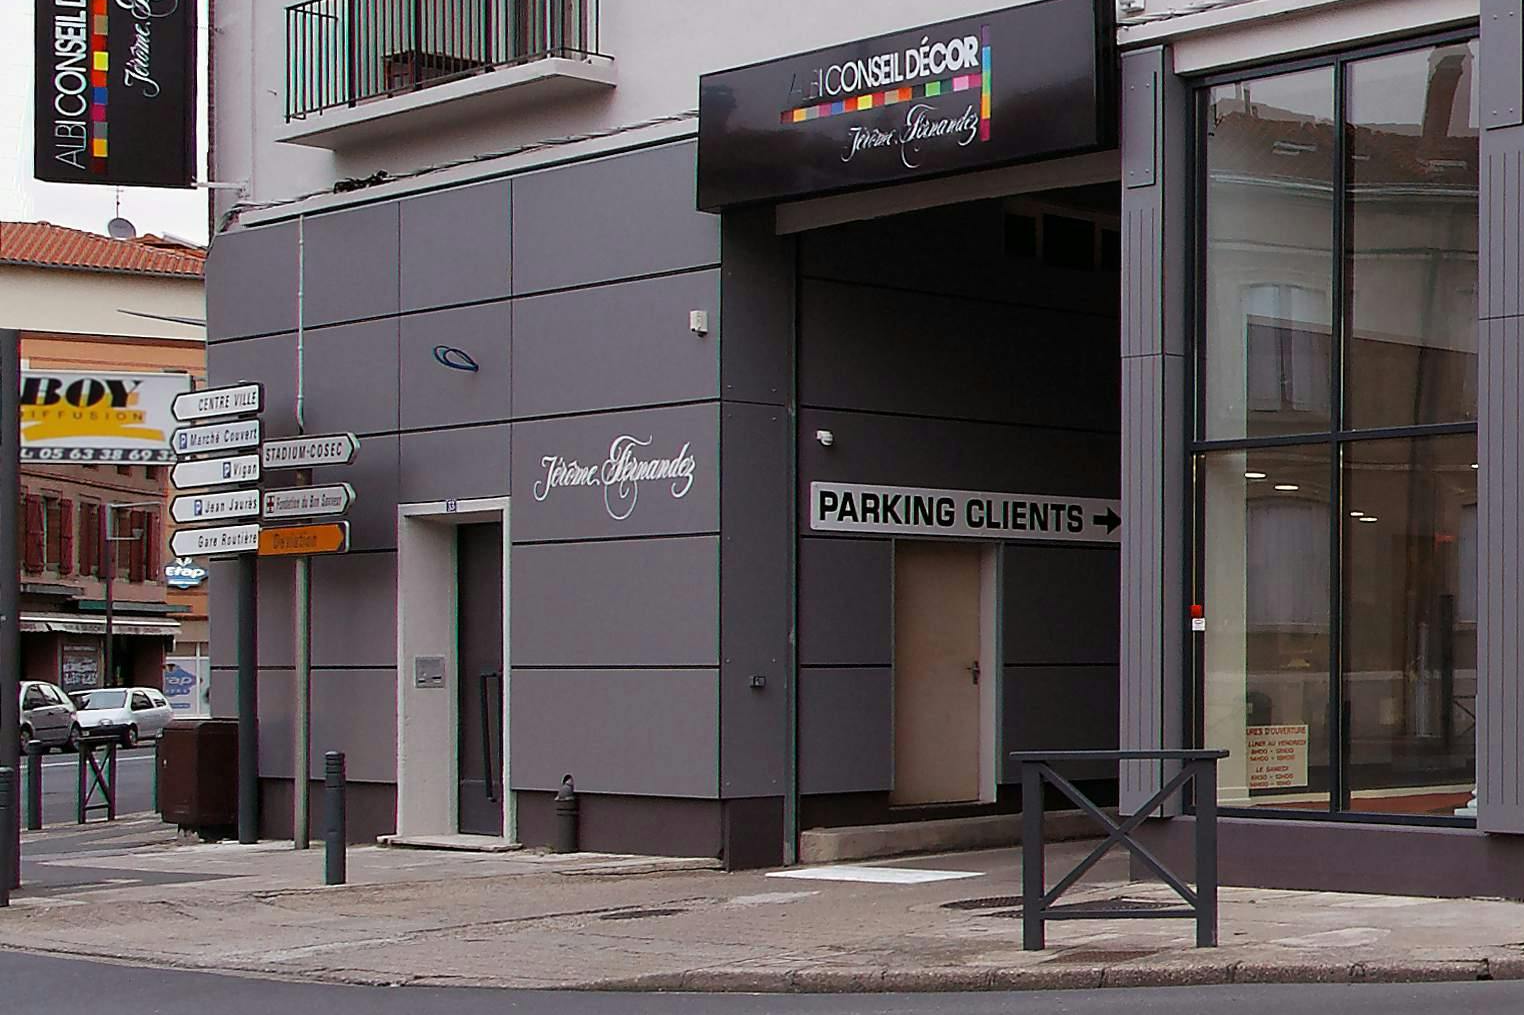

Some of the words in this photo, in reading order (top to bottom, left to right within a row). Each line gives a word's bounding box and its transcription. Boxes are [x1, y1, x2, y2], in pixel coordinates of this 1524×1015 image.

[55, 11, 87, 117] CONSEIL
[124, 22, 160, 97] Jérôme
[825, 51, 904, 95] CONSEIL
[905, 36, 979, 80] DÉCOR
[55, 120, 87, 170] ALBI
[899, 103, 980, 169] Fernandez
[21, 377, 144, 408] BOY
[198, 395, 230, 412] CENTRE
[233, 391, 257, 407] VILLE
[189, 431, 220, 447] Marché
[223, 427, 258, 443] Couvert
[265, 441, 343, 462] STADIUM-COSEC
[39, 449, 63, 459] 05
[69, 449, 94, 460] 63
[101, 450, 122, 460] 38
[129, 450, 152, 461] 69
[232, 461, 257, 479] Vigan
[533, 455, 601, 502] Jérôme
[601, 433, 696, 520] Fernandez
[205, 500, 225, 514] Jean
[229, 495, 257, 512] Jaurès
[819, 489, 956, 528] PARKING
[965, 498, 1084, 533] CLIENTS
[198, 535, 218, 549] Gare
[221, 531, 257, 547] Routière
